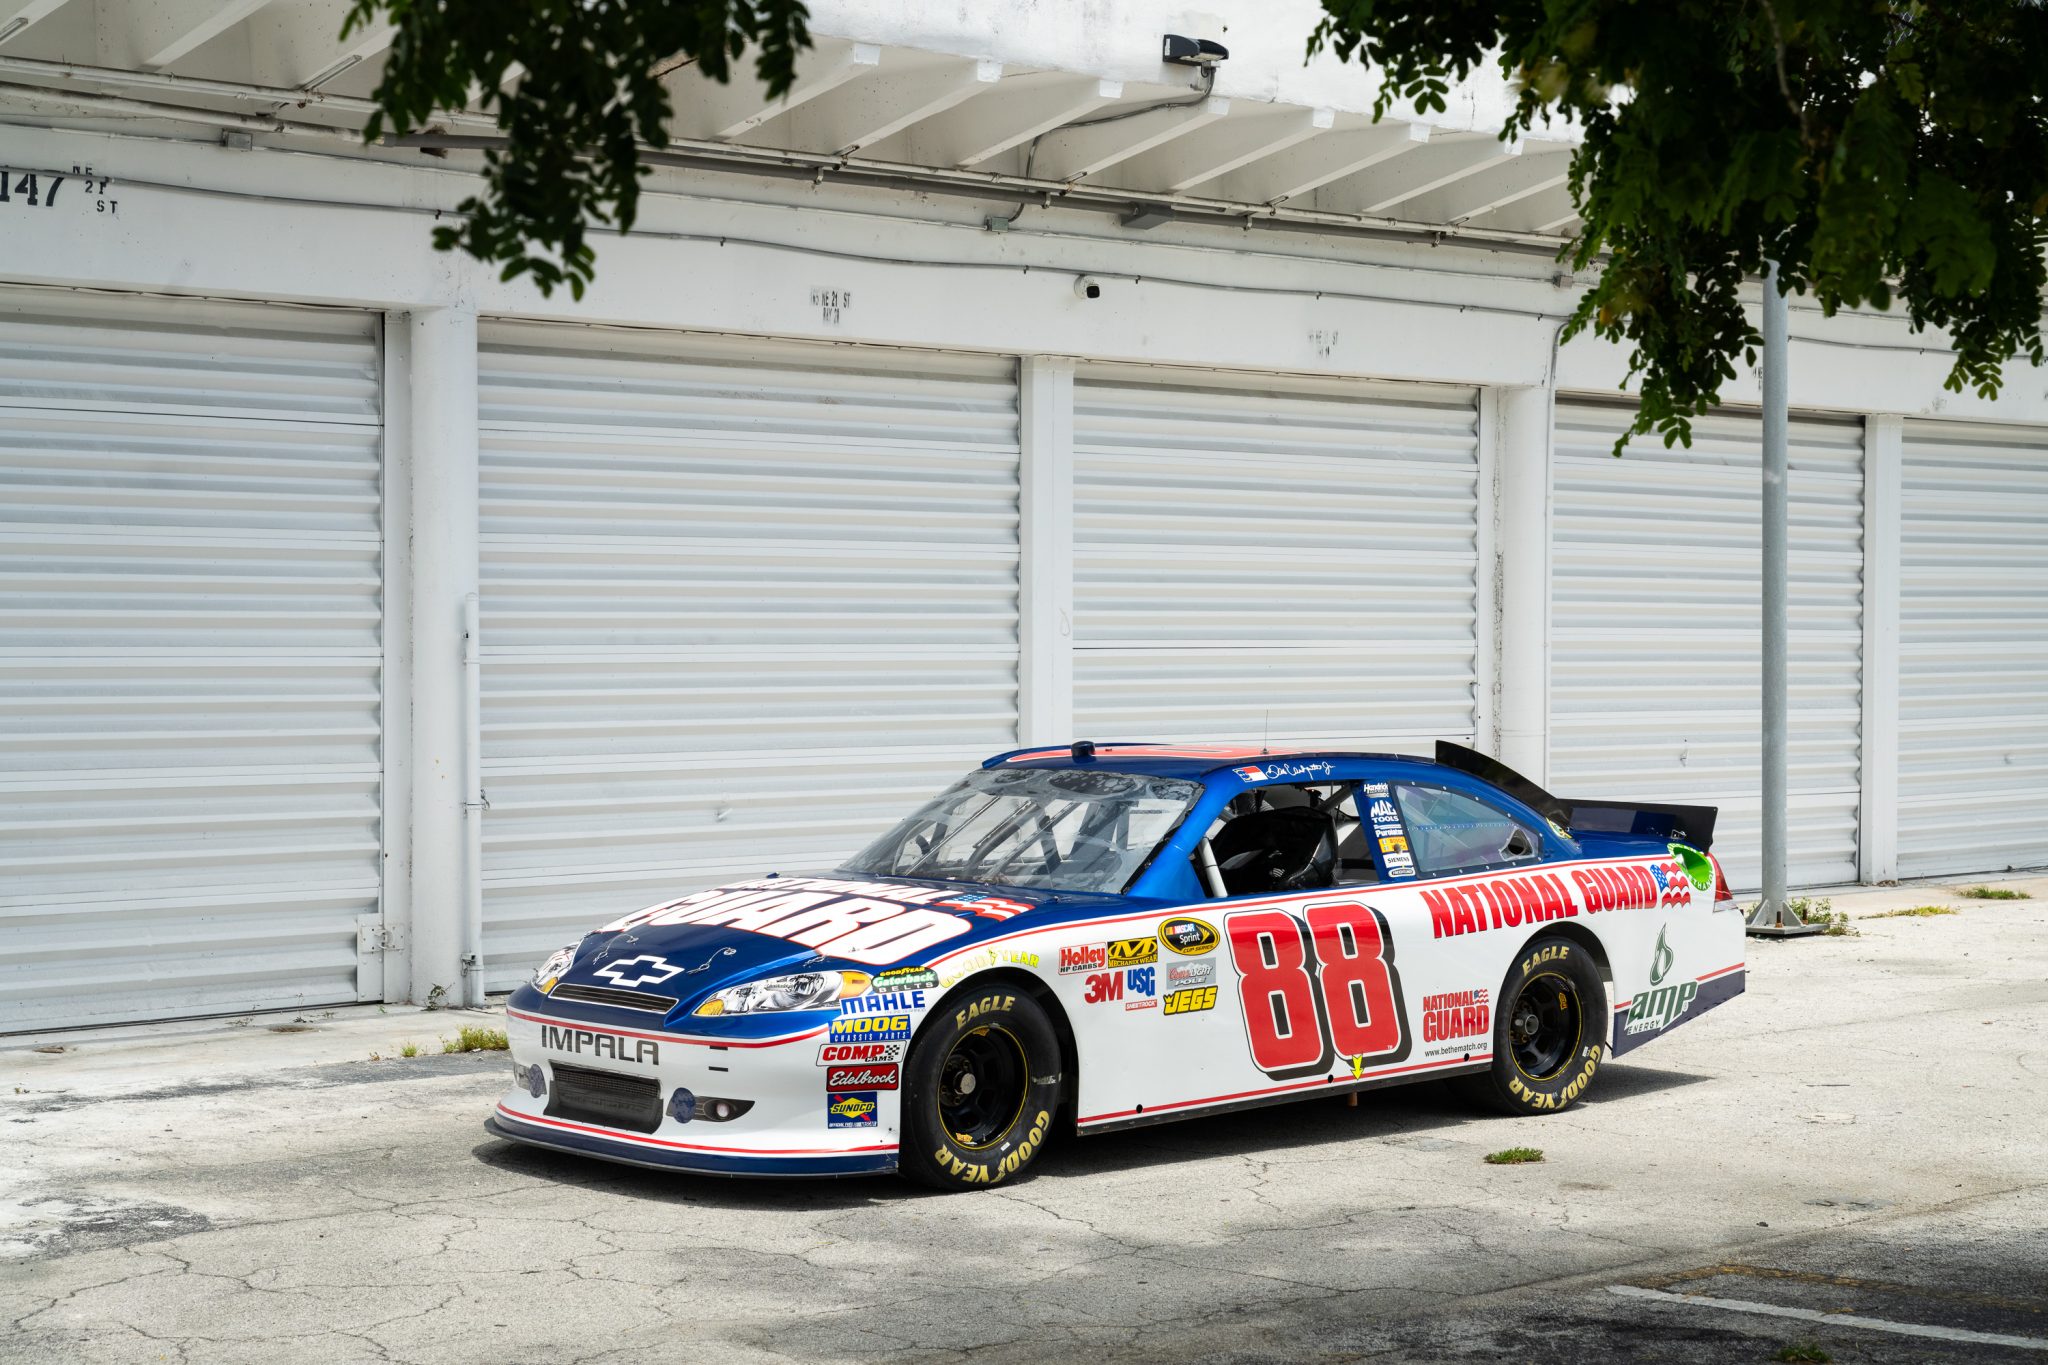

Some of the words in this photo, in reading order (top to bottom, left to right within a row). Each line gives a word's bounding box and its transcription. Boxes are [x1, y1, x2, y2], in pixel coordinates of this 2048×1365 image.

[96, 200, 118, 213] ST
[843, 292, 851, 308] ST
[1371, 800, 1397, 818] MAC
[1387, 856, 1410, 864] SIEMENS
[1419, 873, 1578, 939] NATIONAL
[1571, 865, 1657, 914] GUARD
[1174, 923, 1195, 934] NASCAR
[1180, 933, 1201, 945] Sprint
[1060, 946, 1105, 968] Holley
[1108, 959, 1139, 968] MECHANIX
[1140, 954, 1158, 964] WEAR
[1521, 945, 1570, 978] EAGLE
[880, 966, 925, 977] GOODYEAR
[1072, 962, 1098, 971] CARBS
[872, 971, 936, 987] Gatorback
[879, 982, 934, 993] BELTS
[1084, 970, 1123, 1004] 3M
[1128, 966, 1155, 997] USG
[1174, 977, 1206, 987] POLE
[1163, 985, 1218, 1015] JEGS
[1224, 901, 1412, 1081] 88
[841, 991, 926, 1015] MAHLE
[1423, 990, 1475, 1012] NATIONAL
[956, 995, 1015, 1030] EAGLE
[831, 1016, 909, 1034] MOOG
[1423, 1004, 1489, 1043] GUARD
[1626, 1019, 1661, 1035] ENERGY
[541, 1024, 660, 1066] IMPALA
[834, 1033, 873, 1042] CHASSIS
[879, 1031, 906, 1040] PARTS
[822, 1045, 885, 1061] COMP
[1424, 1042, 1488, 1057] www.bethematch.org
[829, 1069, 896, 1087] Edelbrock
[1508, 1044, 1601, 1110] GOODYEAR
[833, 1103, 873, 1113] SUNOCO
[934, 1110, 1050, 1184] GOODYEAR
